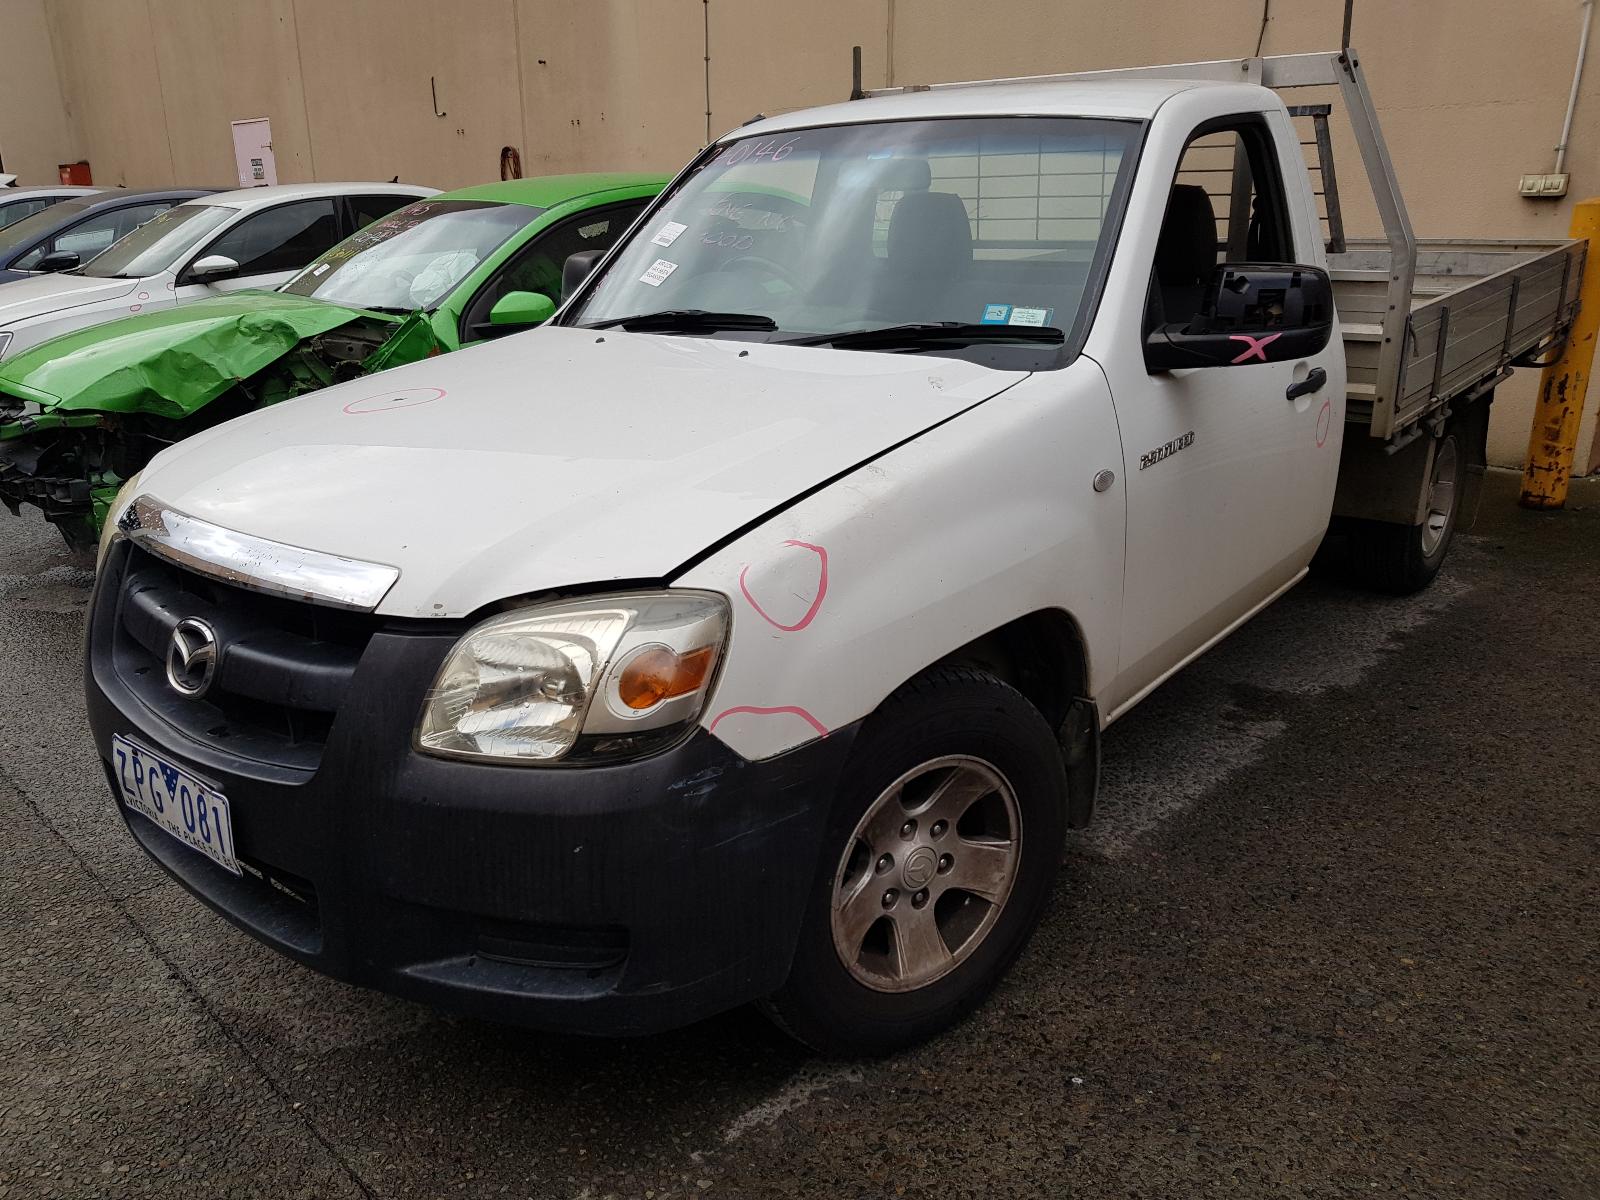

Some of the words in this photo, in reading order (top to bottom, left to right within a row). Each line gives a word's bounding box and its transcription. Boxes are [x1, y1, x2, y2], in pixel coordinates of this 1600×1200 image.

[116, 748, 164, 813] ZPG
[181, 784, 226, 856] 081
[127, 796, 159, 821] VICTORIA
[167, 819, 182, 838] THE
